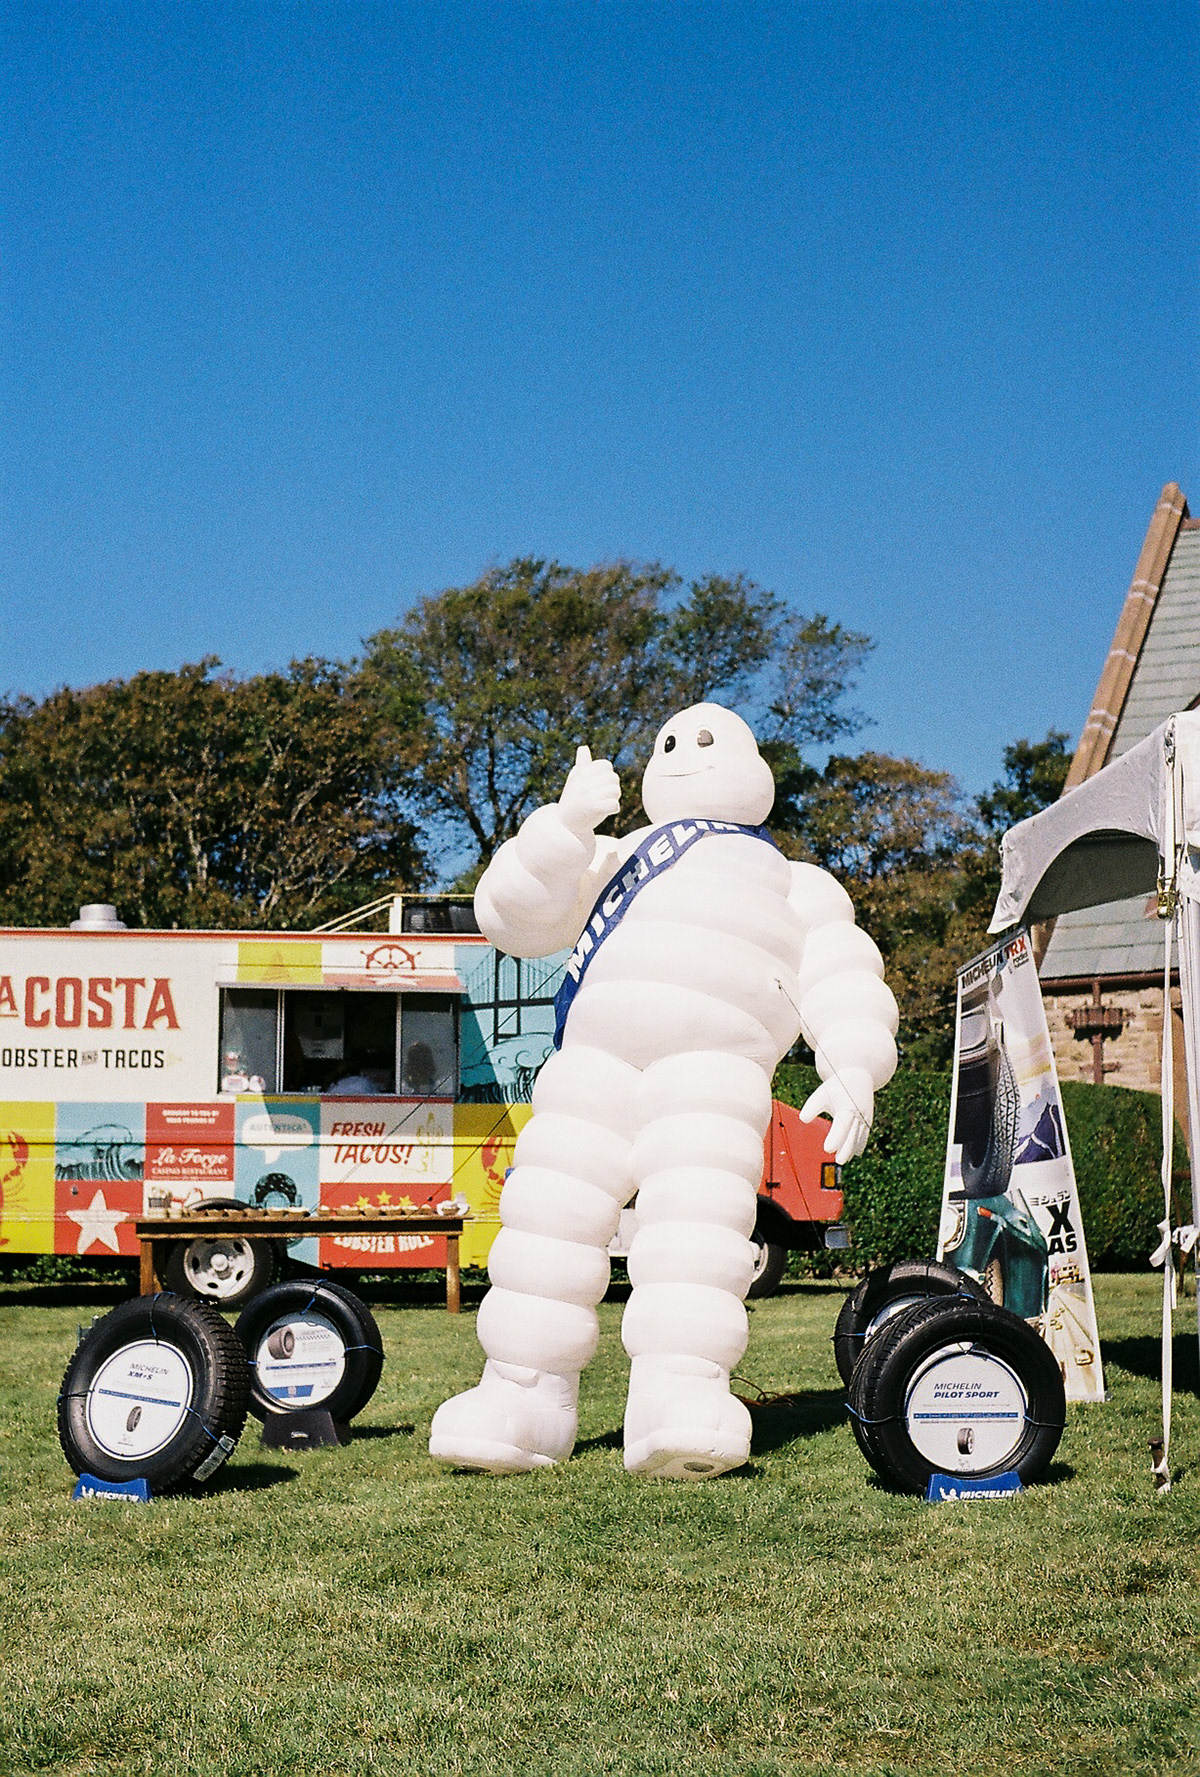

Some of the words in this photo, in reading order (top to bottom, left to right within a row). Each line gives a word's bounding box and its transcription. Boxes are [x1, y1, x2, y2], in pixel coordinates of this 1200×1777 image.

[961, 950, 1004, 989] MICHELIN
[1004, 936, 1027, 959] TRX
[102, 1049, 165, 1069] TACOS
[330, 1122, 386, 1136] FRESH
[151, 1146, 175, 1166] La
[177, 1147, 229, 1168] Forge
[334, 1144, 414, 1165] TACOS!
[1029, 1190, 1071, 1206] ミシュラン
[1045, 1200, 1075, 1237] X
[1047, 1233, 1078, 1255] AS
[130, 1363, 169, 1375] MICHELIN
[934, 1391, 964, 1399] PILOT
[965, 1391, 1000, 1399] SPORT
[960, 1490, 1016, 1499] MICHELIN
